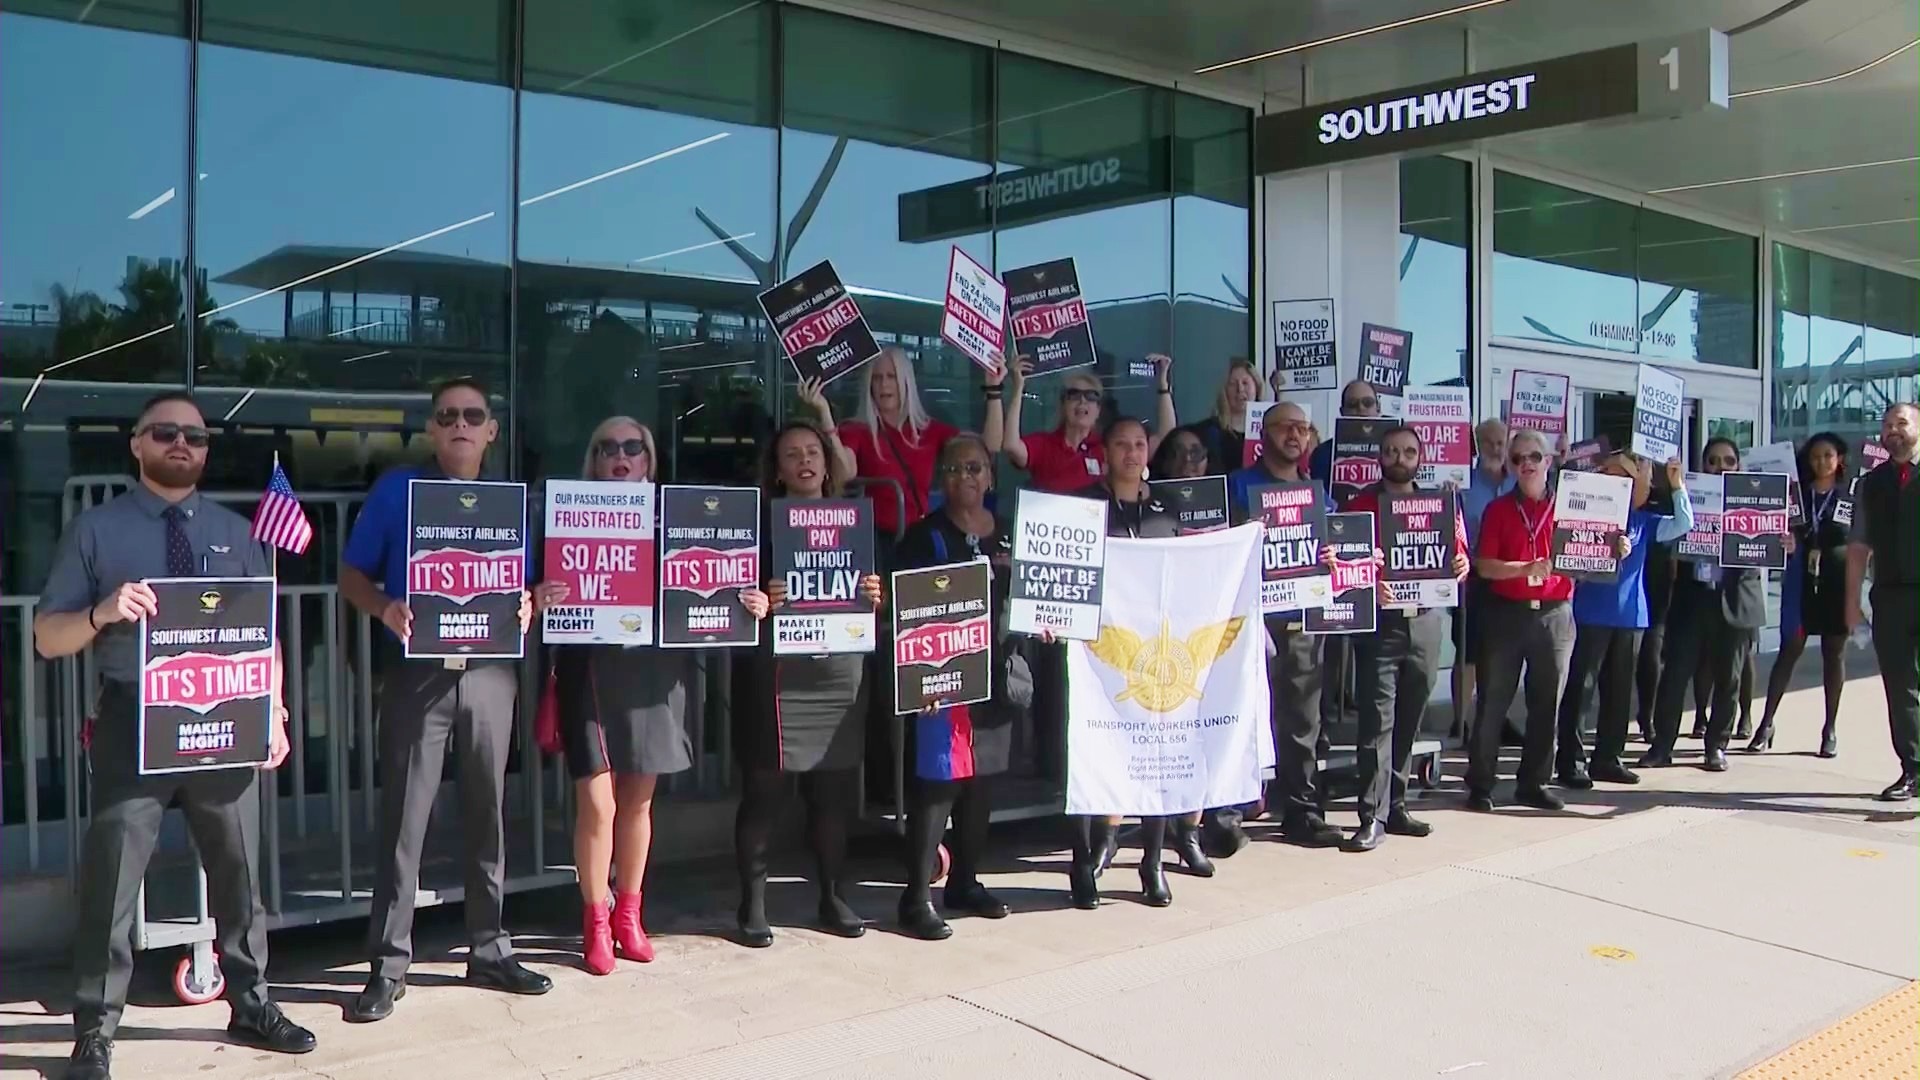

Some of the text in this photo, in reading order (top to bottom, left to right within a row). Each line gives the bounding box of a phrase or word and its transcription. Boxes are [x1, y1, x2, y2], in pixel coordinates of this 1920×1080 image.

[1658, 47, 1679, 91] 1
[1318, 74, 1536, 145] SOUTHWEST
[954, 272, 969, 289] END
[1010, 290, 1047, 304] SOUTHWEST
[785, 301, 855, 352] IT'S TIME!
[948, 298, 1001, 345] SAFETY FIRST
[1014, 303, 1082, 337] IT'S TIME!
[1280, 319, 1329, 331] NO FOOD
[957, 331, 984, 356] RIGHT!
[1283, 330, 1327, 342] NO REST
[816, 341, 849, 362] MAKE IT
[1037, 341, 1068, 352] MAKE IT
[1280, 344, 1332, 358] I CAN'T BE
[820, 348, 854, 370] RIGHT!
[1038, 348, 1071, 362] RIGHT!
[1285, 355, 1329, 369] MY BEST
[1294, 375, 1319, 384] RIGHT!
[1363, 365, 1402, 388] DELAY
[1642, 384, 1679, 405] NO FOOD
[1642, 397, 1677, 416] NO REST
[1643, 413, 1678, 431] CAN'T BE
[1434, 426, 1460, 443] ARE
[1640, 422, 1675, 441] MY BEST
[1424, 444, 1449, 462] WE.
[1335, 464, 1358, 480] IT'S
[555, 493, 645, 506] OUR PASSENGERS ARE
[1262, 489, 1312, 508] BOARDING
[1392, 499, 1442, 514] BOARDING
[555, 511, 645, 529] FRUSTRATED.
[789, 509, 856, 527] BOARDING
[1278, 507, 1298, 522] PAY
[1408, 515, 1427, 529] PAY
[1725, 516, 1747, 531] IT'S
[1751, 515, 1784, 531] TIME!
[415, 525, 519, 543] SOUTHWEST AIRLINES,
[667, 527, 754, 541] SOUTHWEST AIRLINES,
[810, 529, 835, 546] PAY
[1025, 521, 1097, 544] NO FOOD
[1267, 524, 1312, 542] WITHOUT
[1396, 531, 1440, 545] WITHOUT
[1571, 529, 1605, 544] SWA'S
[561, 543, 637, 572] SO ARE
[1027, 539, 1093, 562] NO REST
[1263, 539, 1319, 570] DELAY
[1390, 545, 1446, 570] DELAY
[1564, 543, 1611, 556] OUTDATED
[1738, 550, 1767, 558] RIGHT!
[794, 551, 853, 568] WITHOUT
[1558, 557, 1616, 570] TECHNOLOGY
[414, 560, 518, 590] IT'S TIME!
[667, 558, 754, 586] IT'S TIME!
[1019, 564, 1097, 585] I CAN'T BE
[1336, 565, 1372, 586] TIME!
[578, 573, 619, 600] WE.
[786, 569, 861, 601] DELAY
[1025, 581, 1092, 601] MY BEST
[1262, 582, 1295, 592] MAKE IT
[1412, 582, 1420, 590] IT
[1262, 591, 1296, 604] RIGHT!
[547, 608, 594, 617] MAKE IT
[688, 606, 730, 617] MAKE IT
[900, 604, 946, 621] SOUTHWEST
[1036, 604, 1073, 615] MAKE IT
[440, 613, 489, 625] MAKE IT
[547, 619, 594, 630] RIGHT!
[688, 617, 730, 629] RIGHT!
[779, 618, 825, 628] MAKE IT
[1035, 614, 1073, 627] RIGHT!
[151, 627, 268, 645] SOUTHWEST AIRLINES,
[440, 625, 489, 638] RIGHT!
[779, 630, 825, 642] RIGHT!
[900, 626, 985, 662] IT'S TIME!
[150, 662, 267, 701] IT'S TIME!
[922, 671, 962, 685] MAKE IT
[922, 681, 962, 695] RIGHT!
[179, 721, 235, 736] MAKE IT
[1087, 714, 1239, 731] TRANSPORT WORKERS UNION
[179, 734, 235, 750] RIGHT!
[1132, 735, 1167, 745] LOCAL
[1178, 754, 1189, 762] the
[1187, 763, 1194, 771] of
